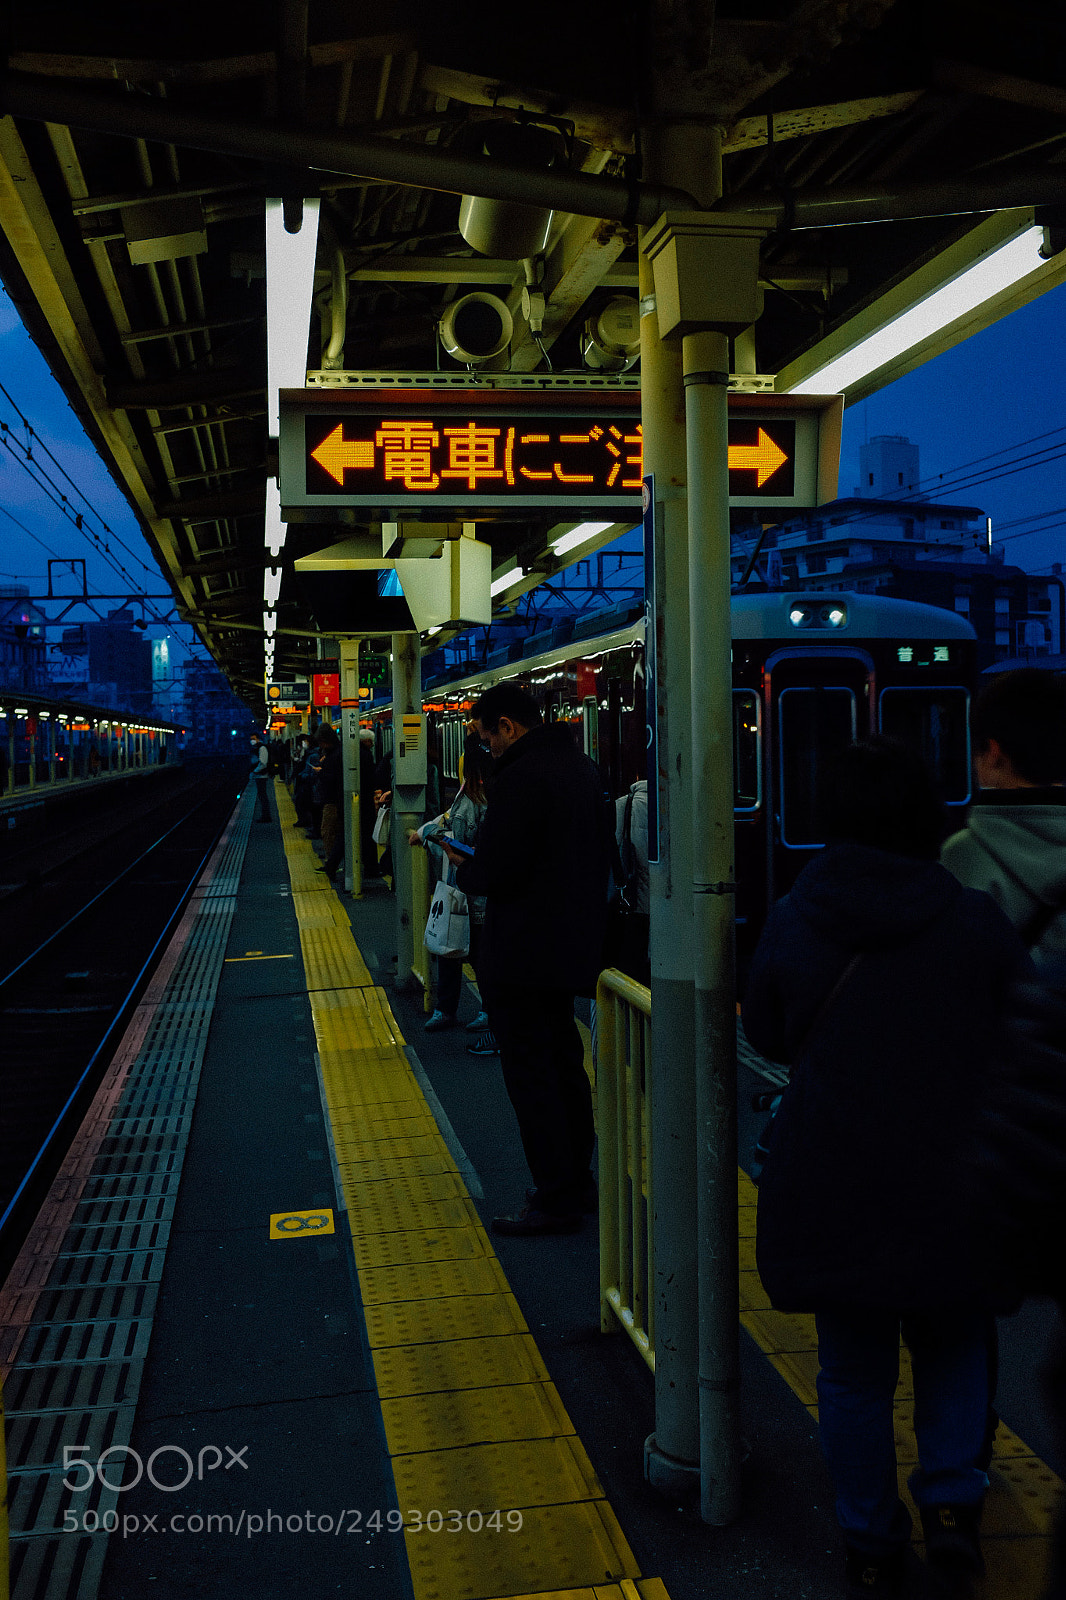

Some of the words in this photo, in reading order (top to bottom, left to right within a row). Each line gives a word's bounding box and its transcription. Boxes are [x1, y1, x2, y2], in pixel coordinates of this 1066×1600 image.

[376, 421, 643, 490] 電車にご注
[276, 1214, 329, 1232] 8
